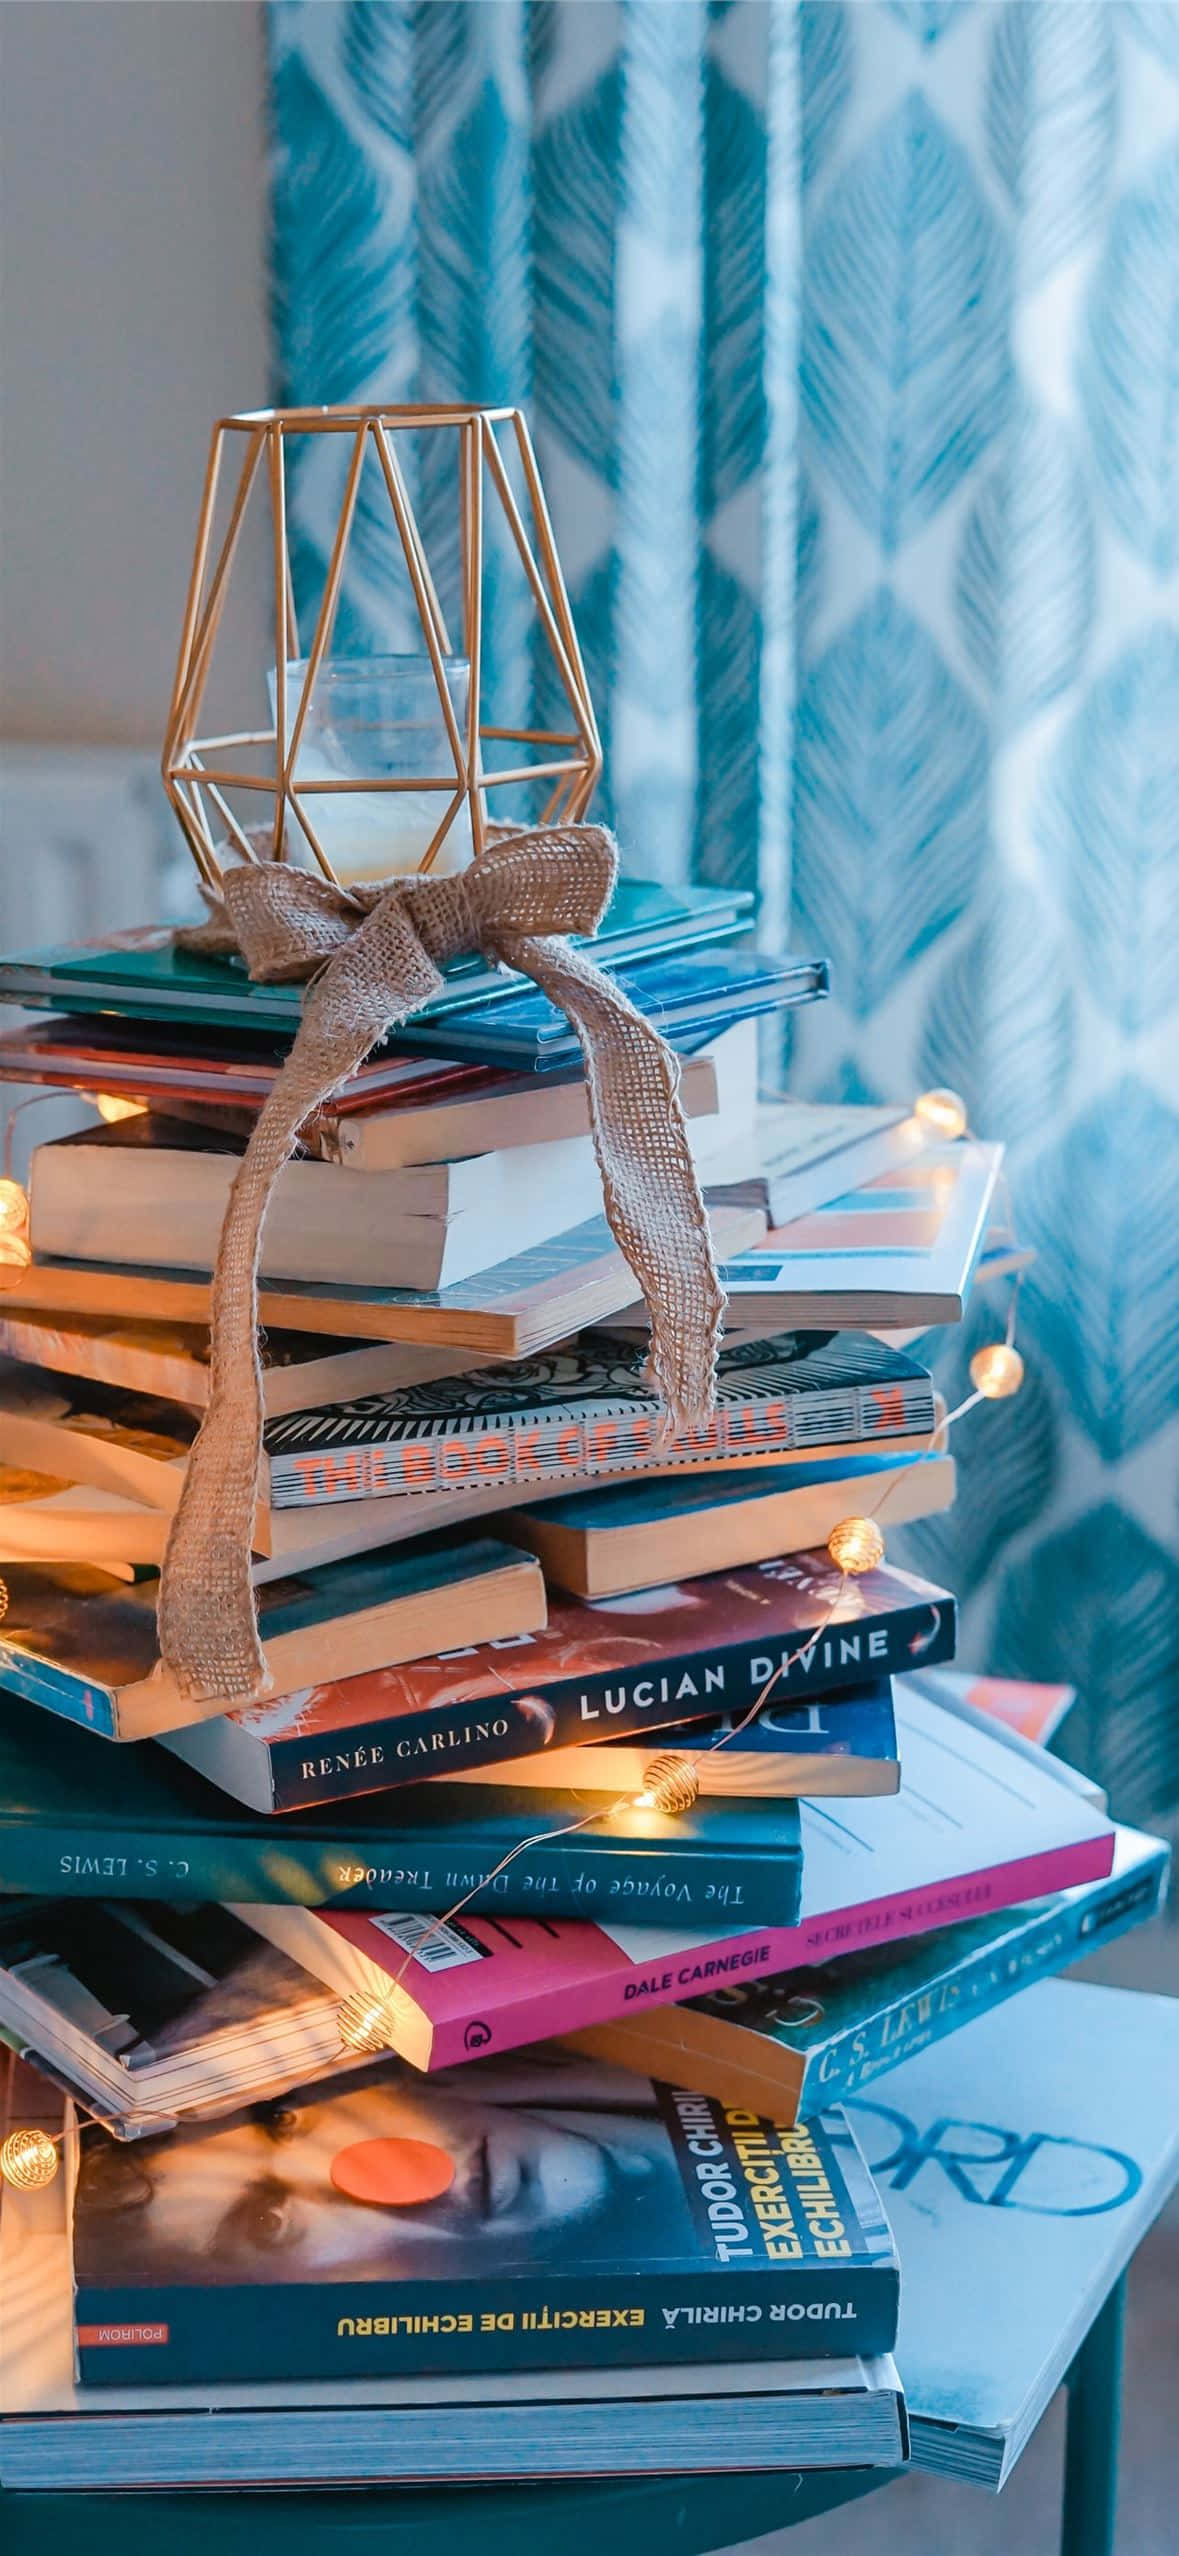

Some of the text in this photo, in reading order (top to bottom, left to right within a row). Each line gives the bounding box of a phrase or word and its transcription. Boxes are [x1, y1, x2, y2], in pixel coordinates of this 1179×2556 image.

[402, 1430, 543, 1488] BOOK
[558, 1423, 618, 1467] OF
[580, 1665, 725, 1721] LUCIAN
[750, 1629, 889, 1685] DIVINE
[301, 1719, 509, 1780] RENÉE CARLINO
[59, 1855, 128, 1877] LEWIS
[570, 1872, 598, 1895] of
[609, 1874, 692, 1902] Voyage
[704, 1883, 745, 1906] The
[624, 1972, 673, 2001] DALE
[677, 1944, 771, 1985] CARNEGIE
[695, 2162, 754, 2262] TUDOR
[480, 2313, 515, 2332] DE
[661, 2304, 764, 2329] CHIRILĂ
[769, 2302, 857, 2322] TUDOR
[99, 2327, 163, 2342] POLIROM
[336, 2313, 474, 2337] ECHILIBRU
